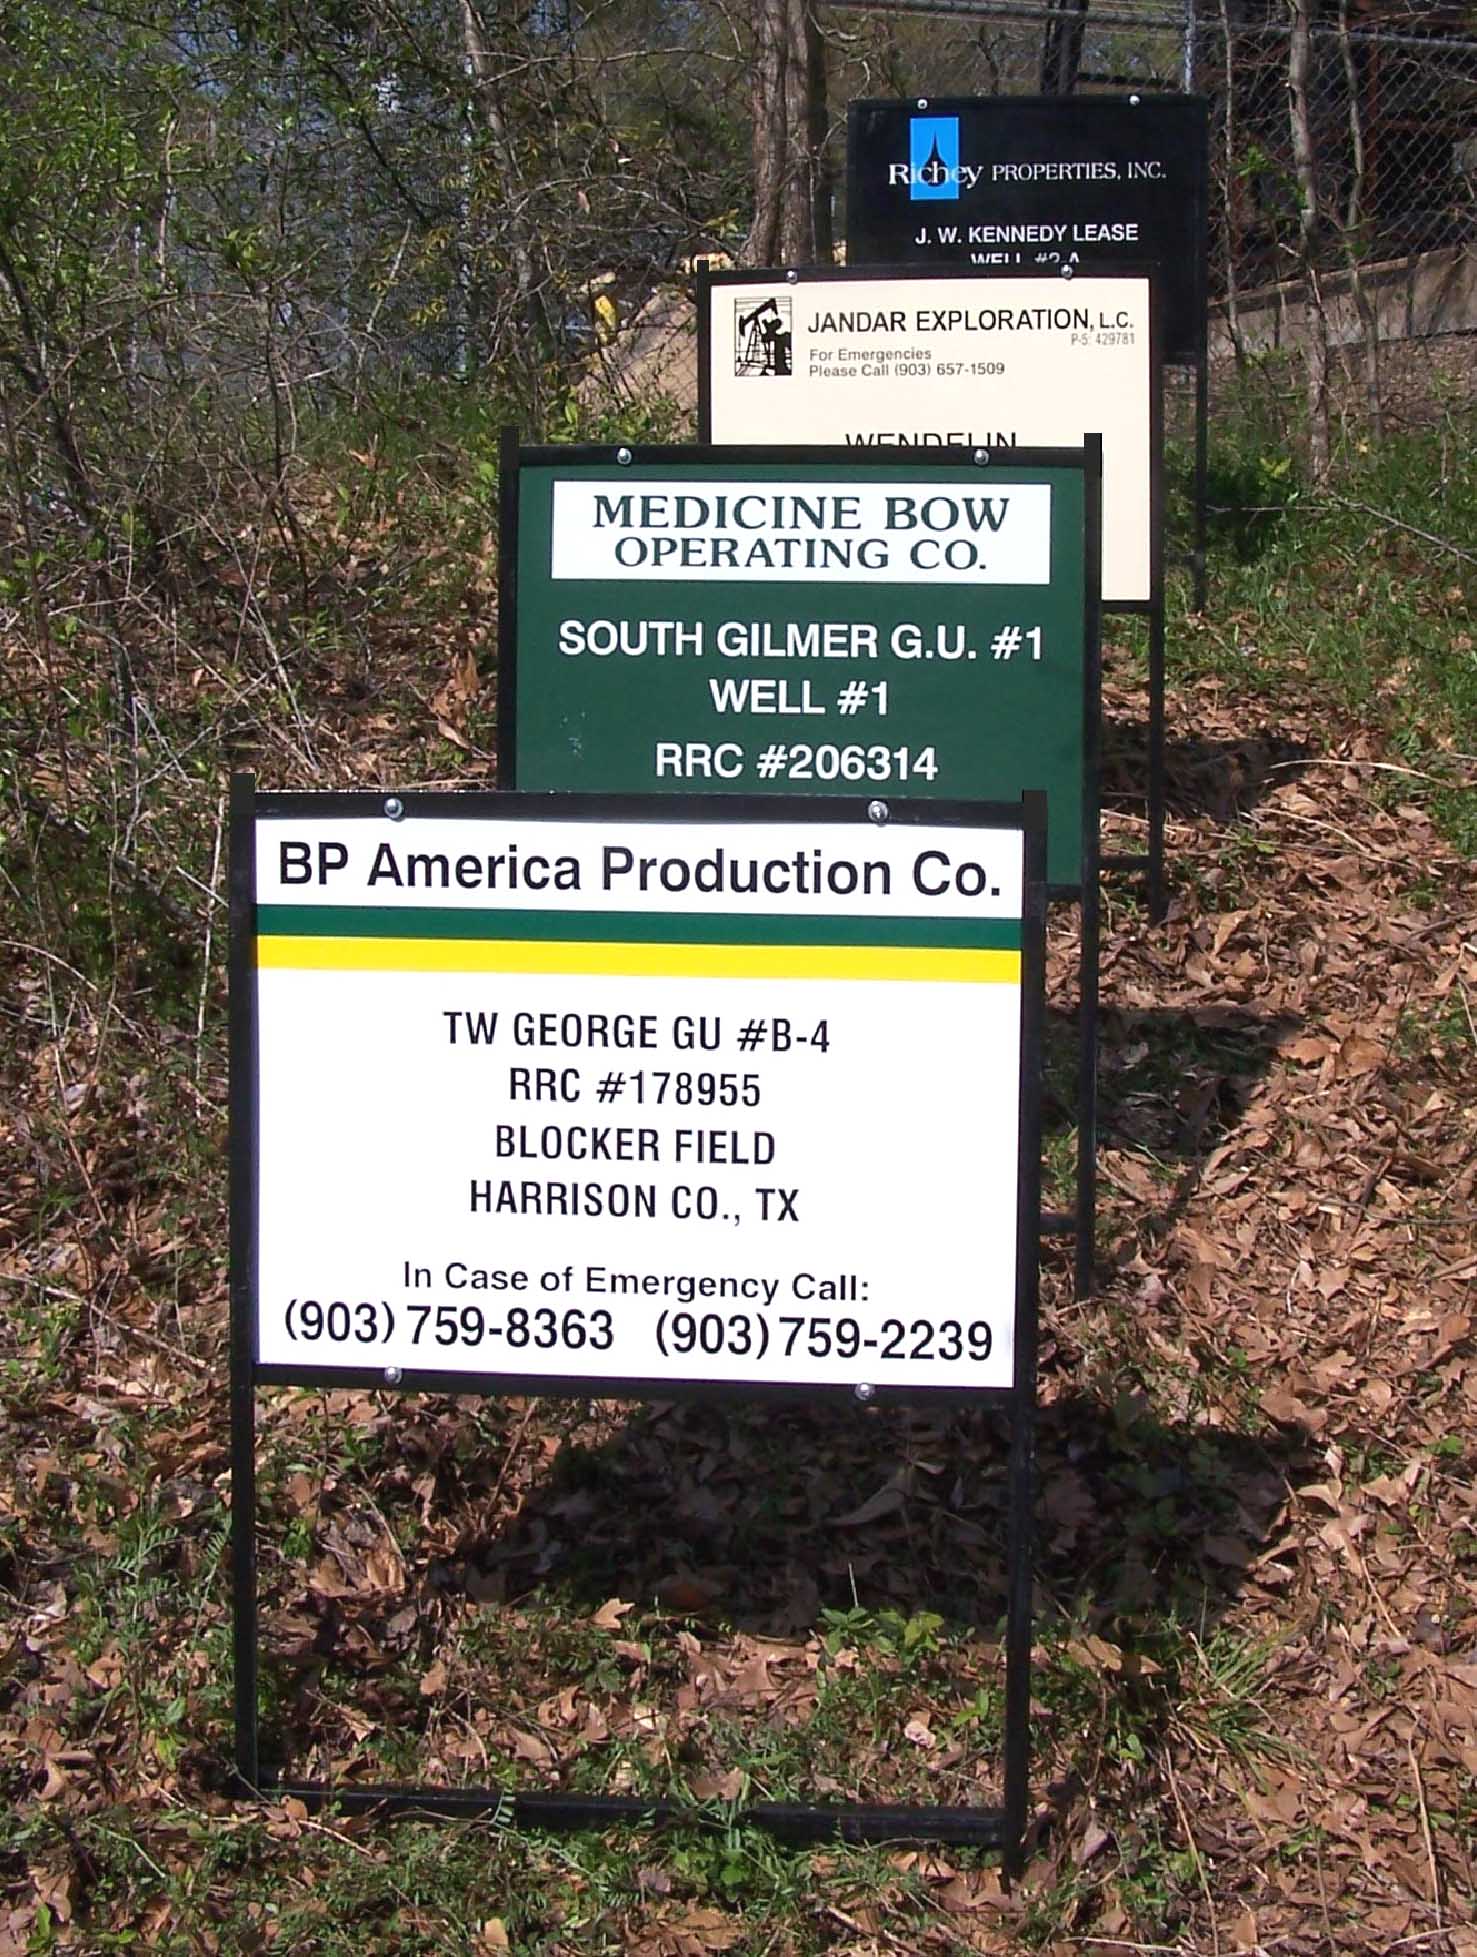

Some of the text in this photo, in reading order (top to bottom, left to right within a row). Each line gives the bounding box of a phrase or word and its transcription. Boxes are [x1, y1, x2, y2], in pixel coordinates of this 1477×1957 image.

[888, 160, 1167, 190] Richey PROPERTIES, INC.
[915, 223, 1139, 245] J. W. KENNEDY LEASE
[807, 311, 907, 334] JANDAR
[916, 308, 1095, 332] EXPLORATION,
[809, 346, 932, 364] For Emergencies
[809, 361, 1006, 377] Please Call (903) 657-1509
[593, 495, 1010, 533] MEDICINE BOW
[614, 536, 987, 570] OPERATING CO.
[558, 619, 1041, 660] SOUTH GILMER G.U. #1
[708, 678, 888, 716] WELL #1
[656, 742, 939, 781] RRC #206314
[279, 841, 1000, 897] BP America Production Co.
[443, 1011, 830, 1053] TW GEORGE GU #B-4
[510, 1067, 761, 1107] RRC #178955
[496, 1124, 775, 1165] BLOCKER FIELD
[470, 1179, 799, 1226] HARRISON CO., TX
[404, 1260, 869, 1307] In Case of Emergency Call:
